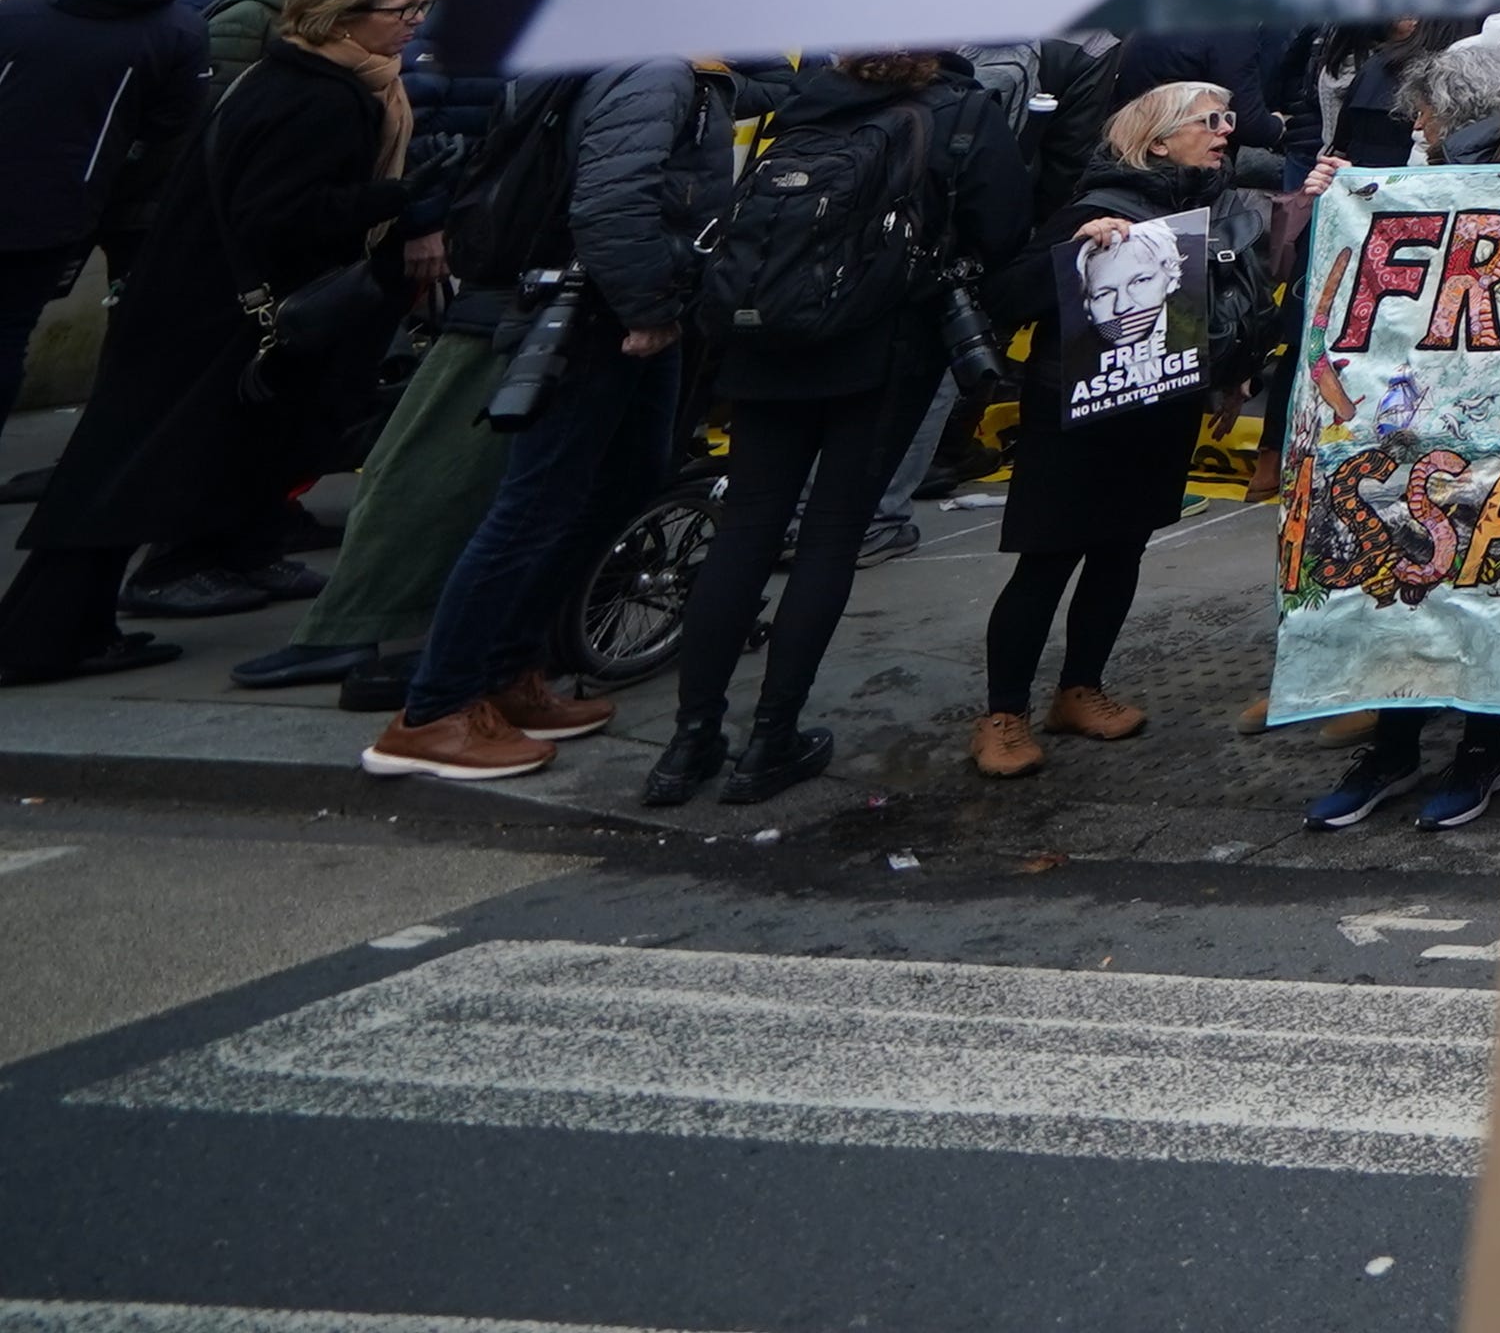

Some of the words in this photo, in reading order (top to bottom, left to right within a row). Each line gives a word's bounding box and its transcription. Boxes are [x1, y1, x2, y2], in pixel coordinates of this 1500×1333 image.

[1071, 347, 1199, 404] ASSANGE
[1100, 335, 1167, 373] FREE
[1071, 405, 1089, 419] NO
[1091, 397, 1115, 412] U.S.
[1117, 372, 1200, 405] EXTRADITION
